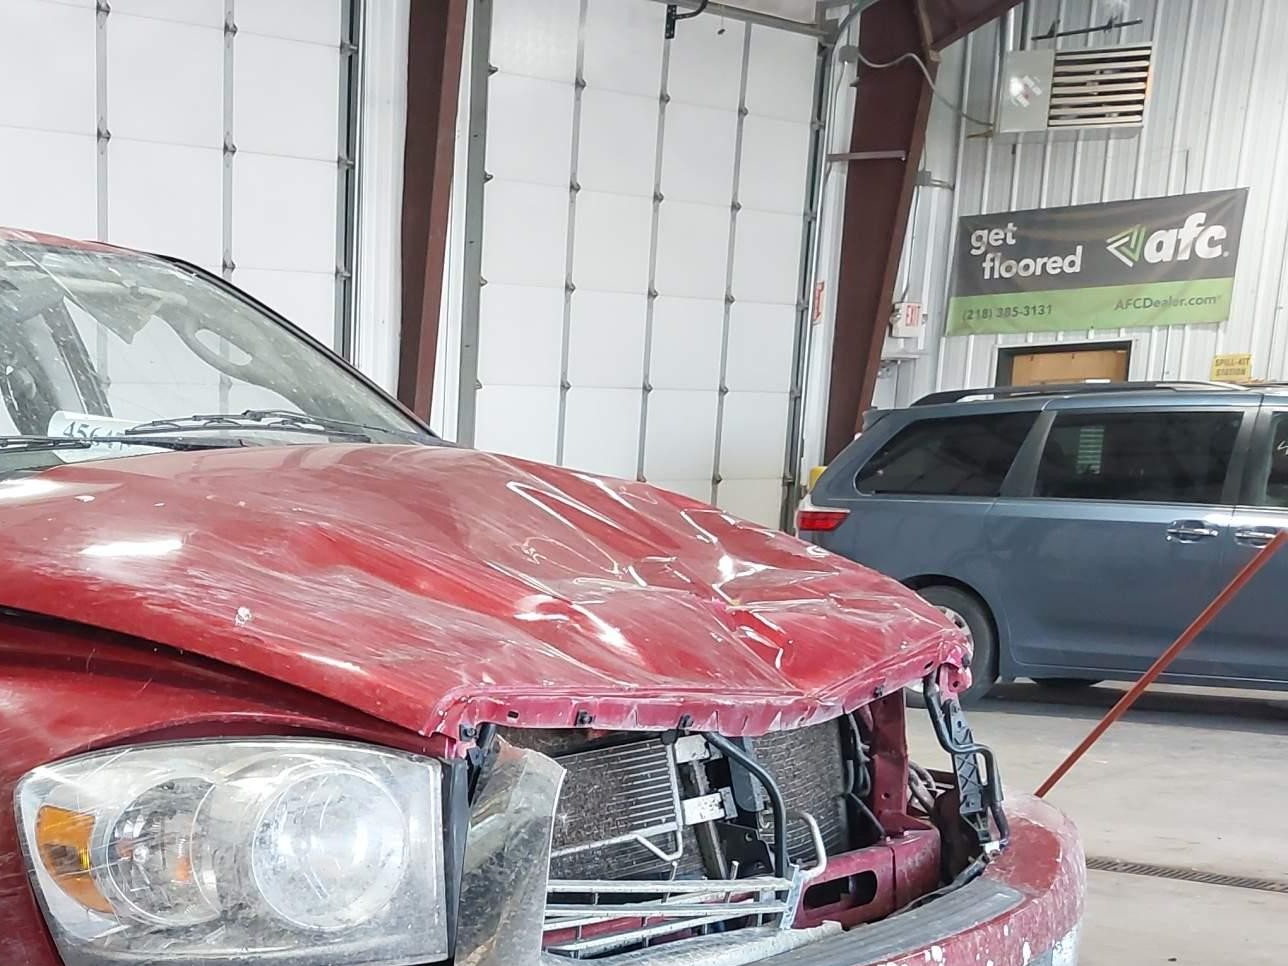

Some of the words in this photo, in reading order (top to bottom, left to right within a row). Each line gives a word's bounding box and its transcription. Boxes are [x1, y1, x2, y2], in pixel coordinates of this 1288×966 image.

[970, 222, 1017, 255] get
[1144, 211, 1227, 263] afc
[982, 245, 1083, 280] floored
[963, 307, 993, 321] (218)
[996, 304, 1052, 319] 385-3131
